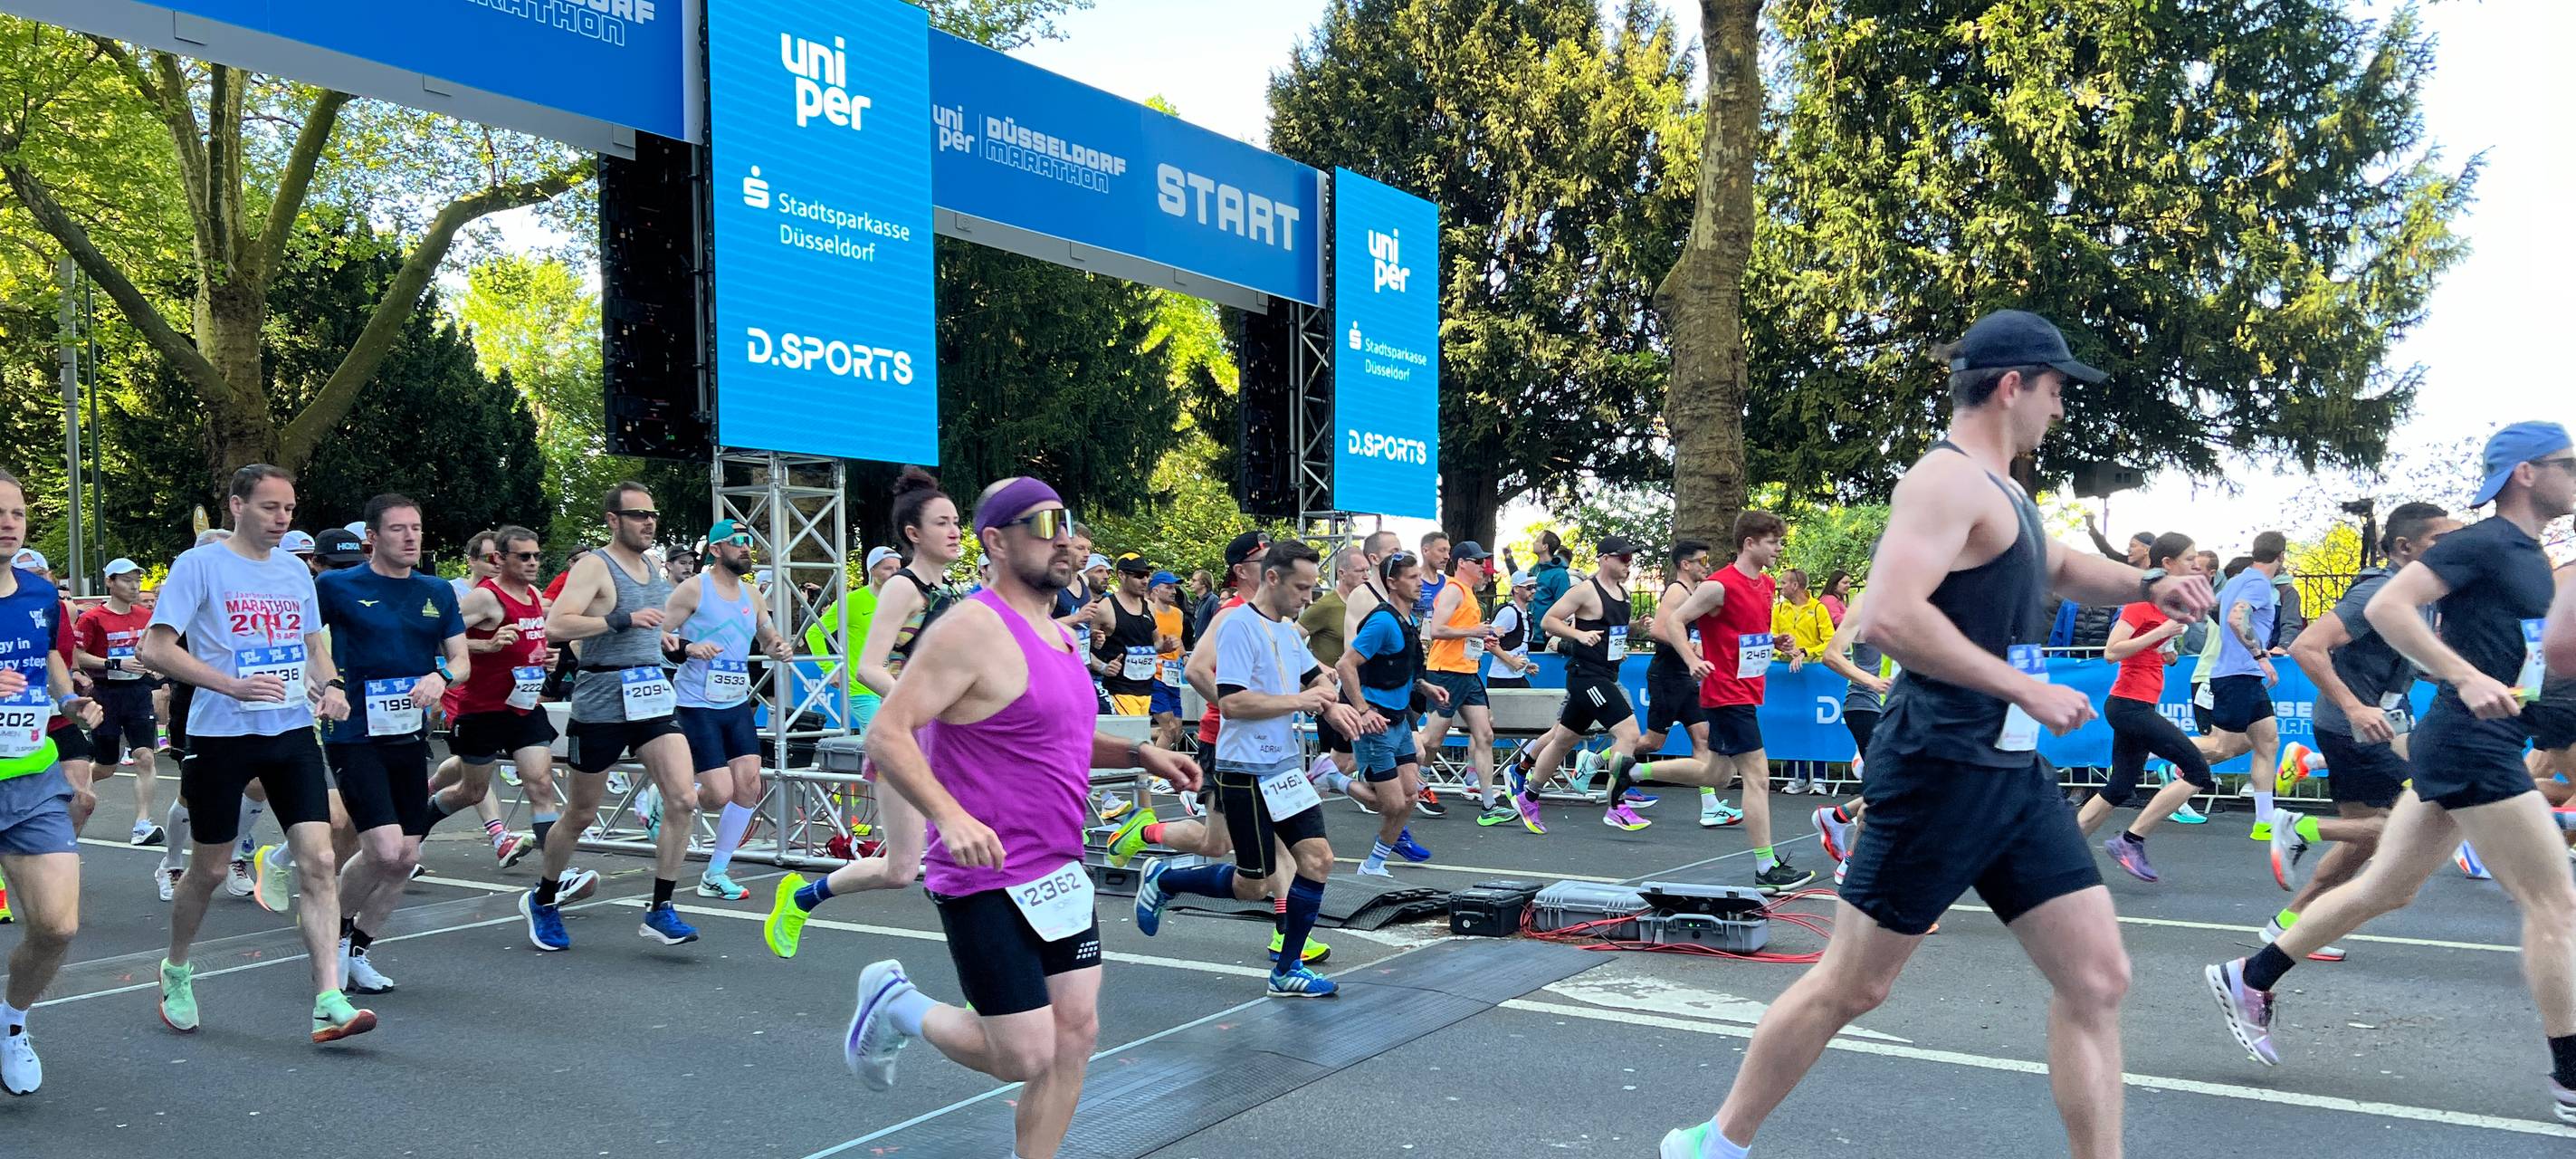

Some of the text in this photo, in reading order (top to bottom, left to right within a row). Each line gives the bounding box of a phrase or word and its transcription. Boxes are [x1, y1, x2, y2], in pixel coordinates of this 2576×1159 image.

[780, 33, 845, 88] uni
[796, 76, 872, 130] per
[932, 104, 963, 131] uni
[939, 126, 975, 154] per
[987, 116, 1126, 177] DÜSSELDORF
[986, 139, 1109, 194] MARATHON
[778, 192, 911, 242] Stadtsparkasse
[1157, 163, 1300, 251] START
[779, 224, 876, 262] Düsseldorf
[1368, 228, 1399, 263] uni
[1374, 258, 1411, 293] per
[747, 327, 913, 386] D.SPORTS
[1365, 338, 1427, 366] Stadtsparkasse
[1365, 359, 1410, 382] Düsseldorf
[1348, 428, 1426, 465] D.SPORTS
[225, 599, 301, 613] MARATHON
[230, 614, 301, 633] 2012
[17, 637, 31, 649] in
[253, 668, 300, 682] 38
[714, 675, 746, 685] 3533
[379, 698, 419, 712] 799
[2271, 701, 2313, 718] SE
[1024, 872, 1082, 906] 2362
